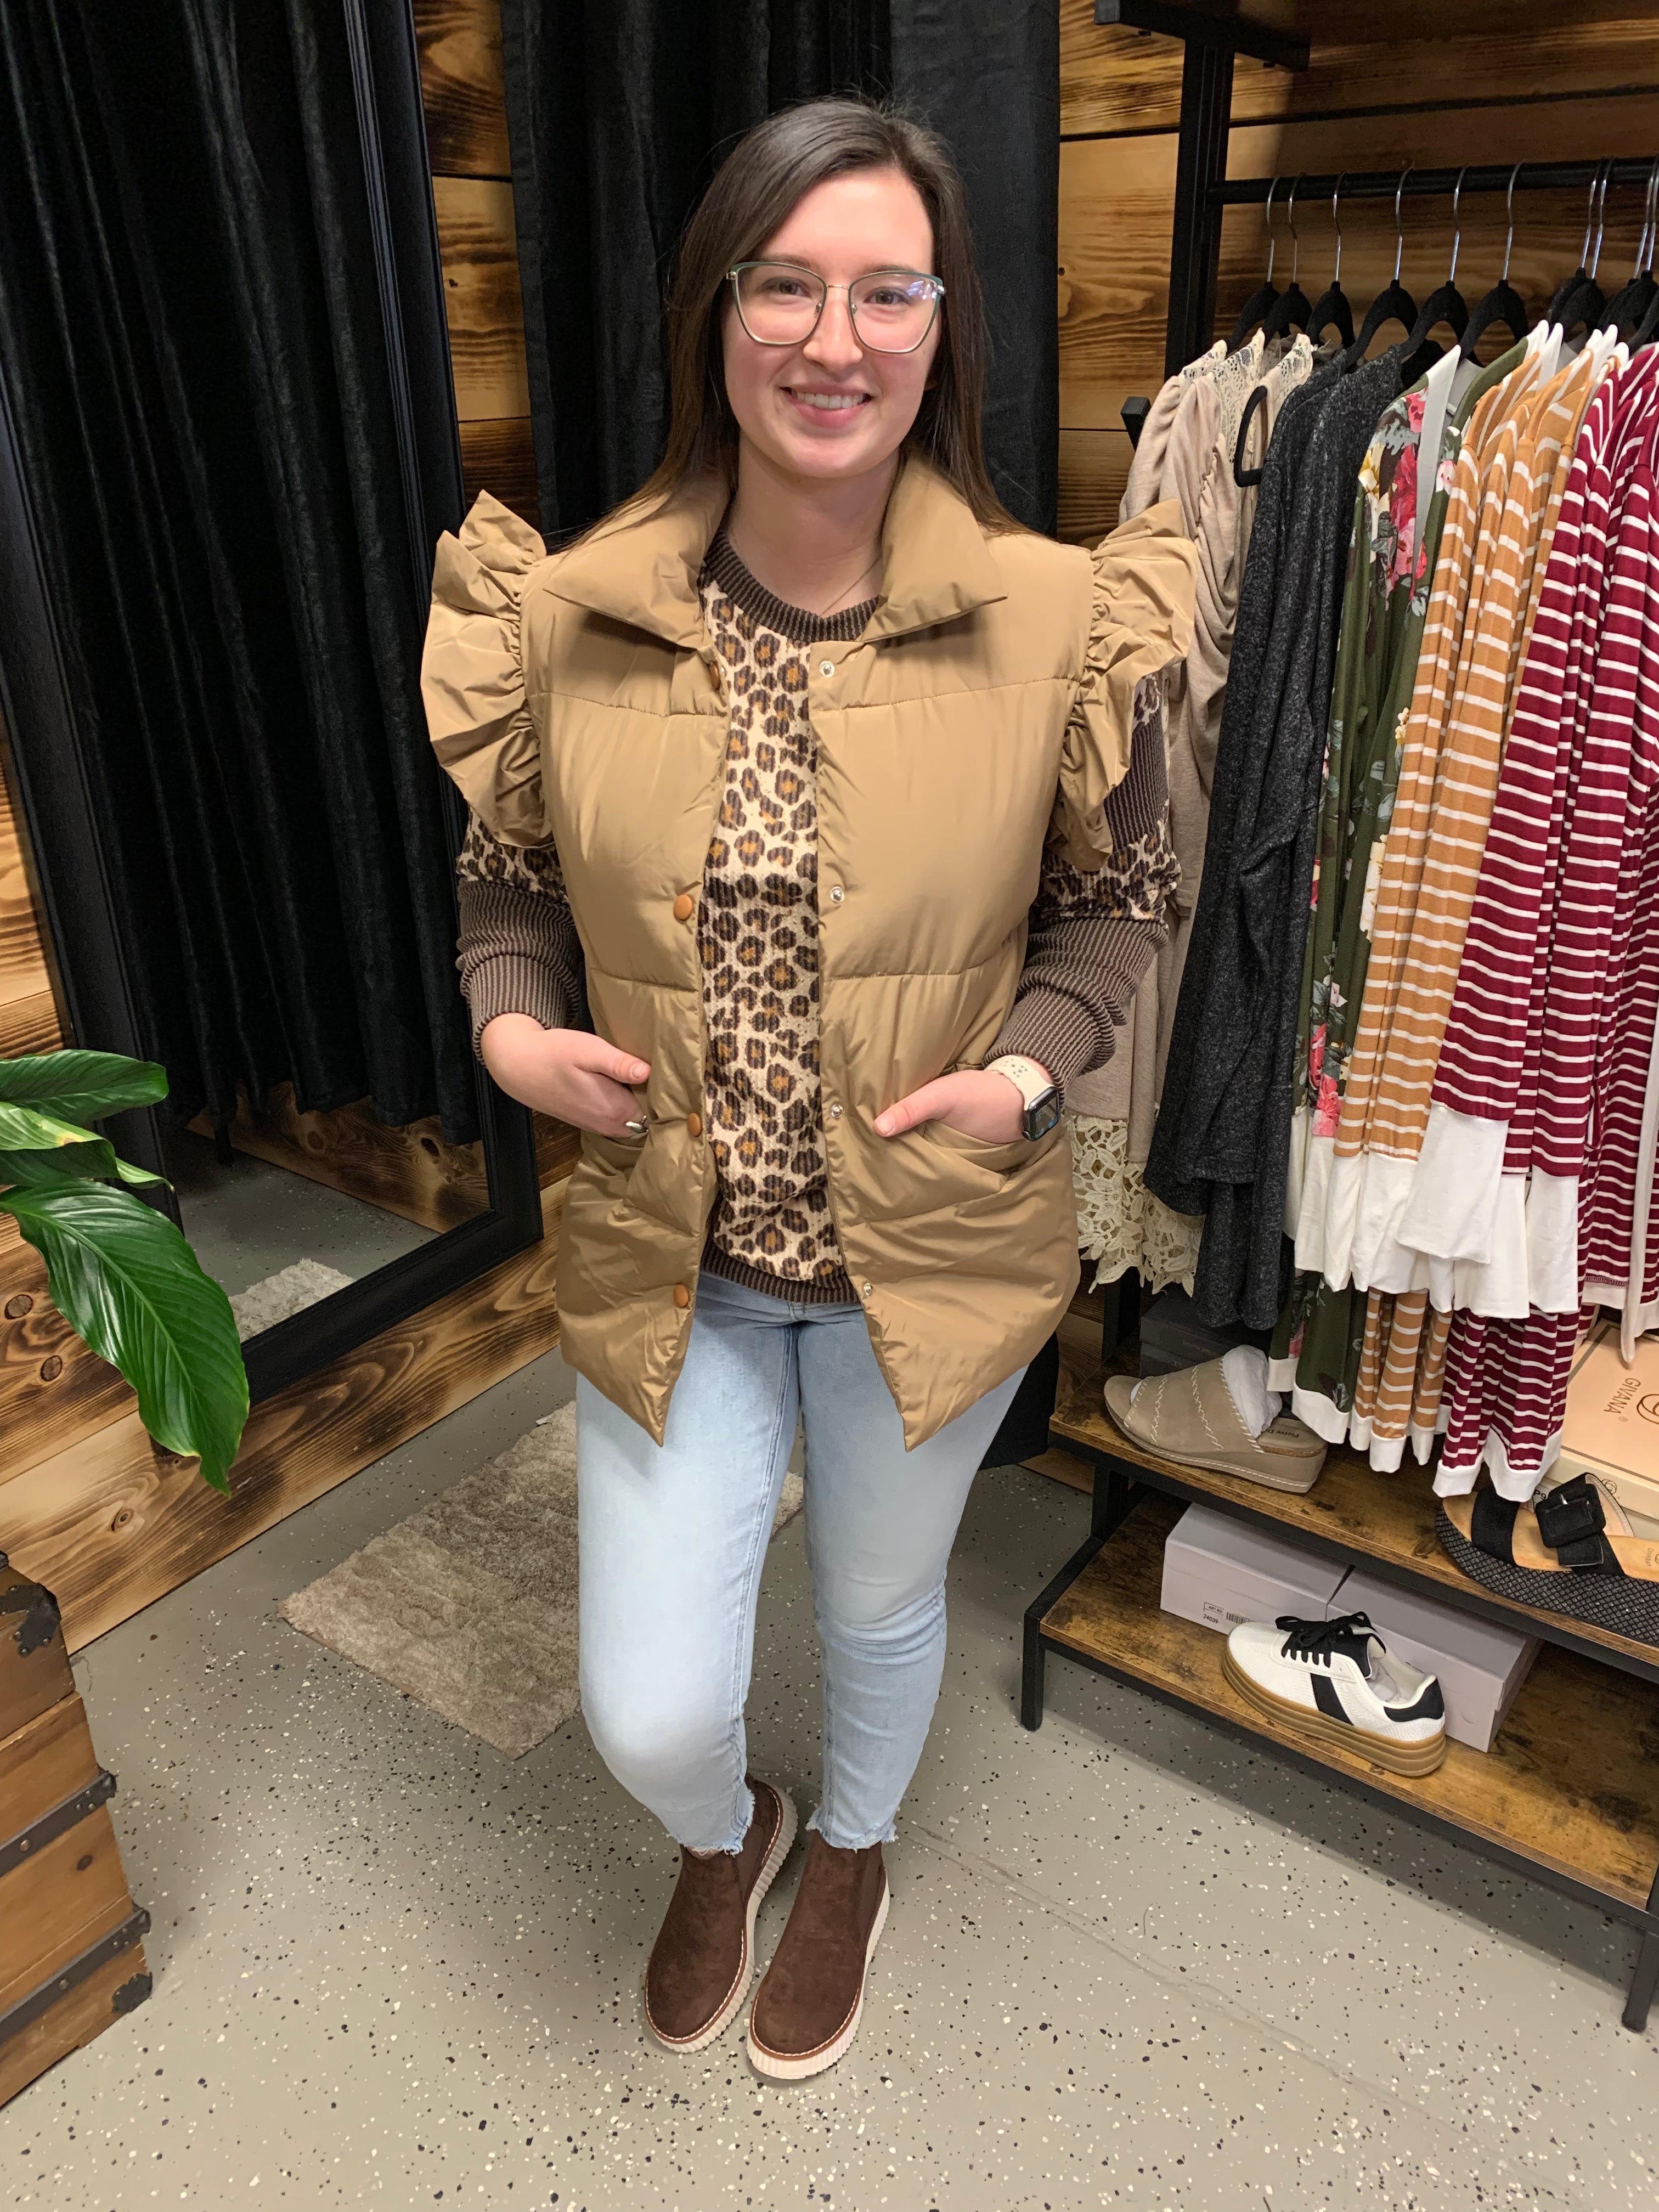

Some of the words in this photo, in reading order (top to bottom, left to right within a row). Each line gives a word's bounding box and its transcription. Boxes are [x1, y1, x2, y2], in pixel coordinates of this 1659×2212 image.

[1604, 1378, 1641, 1413] GIVANA
[1276, 1430, 1300, 1438] Pierre
[1203, 1613, 1218, 1624] 24039
